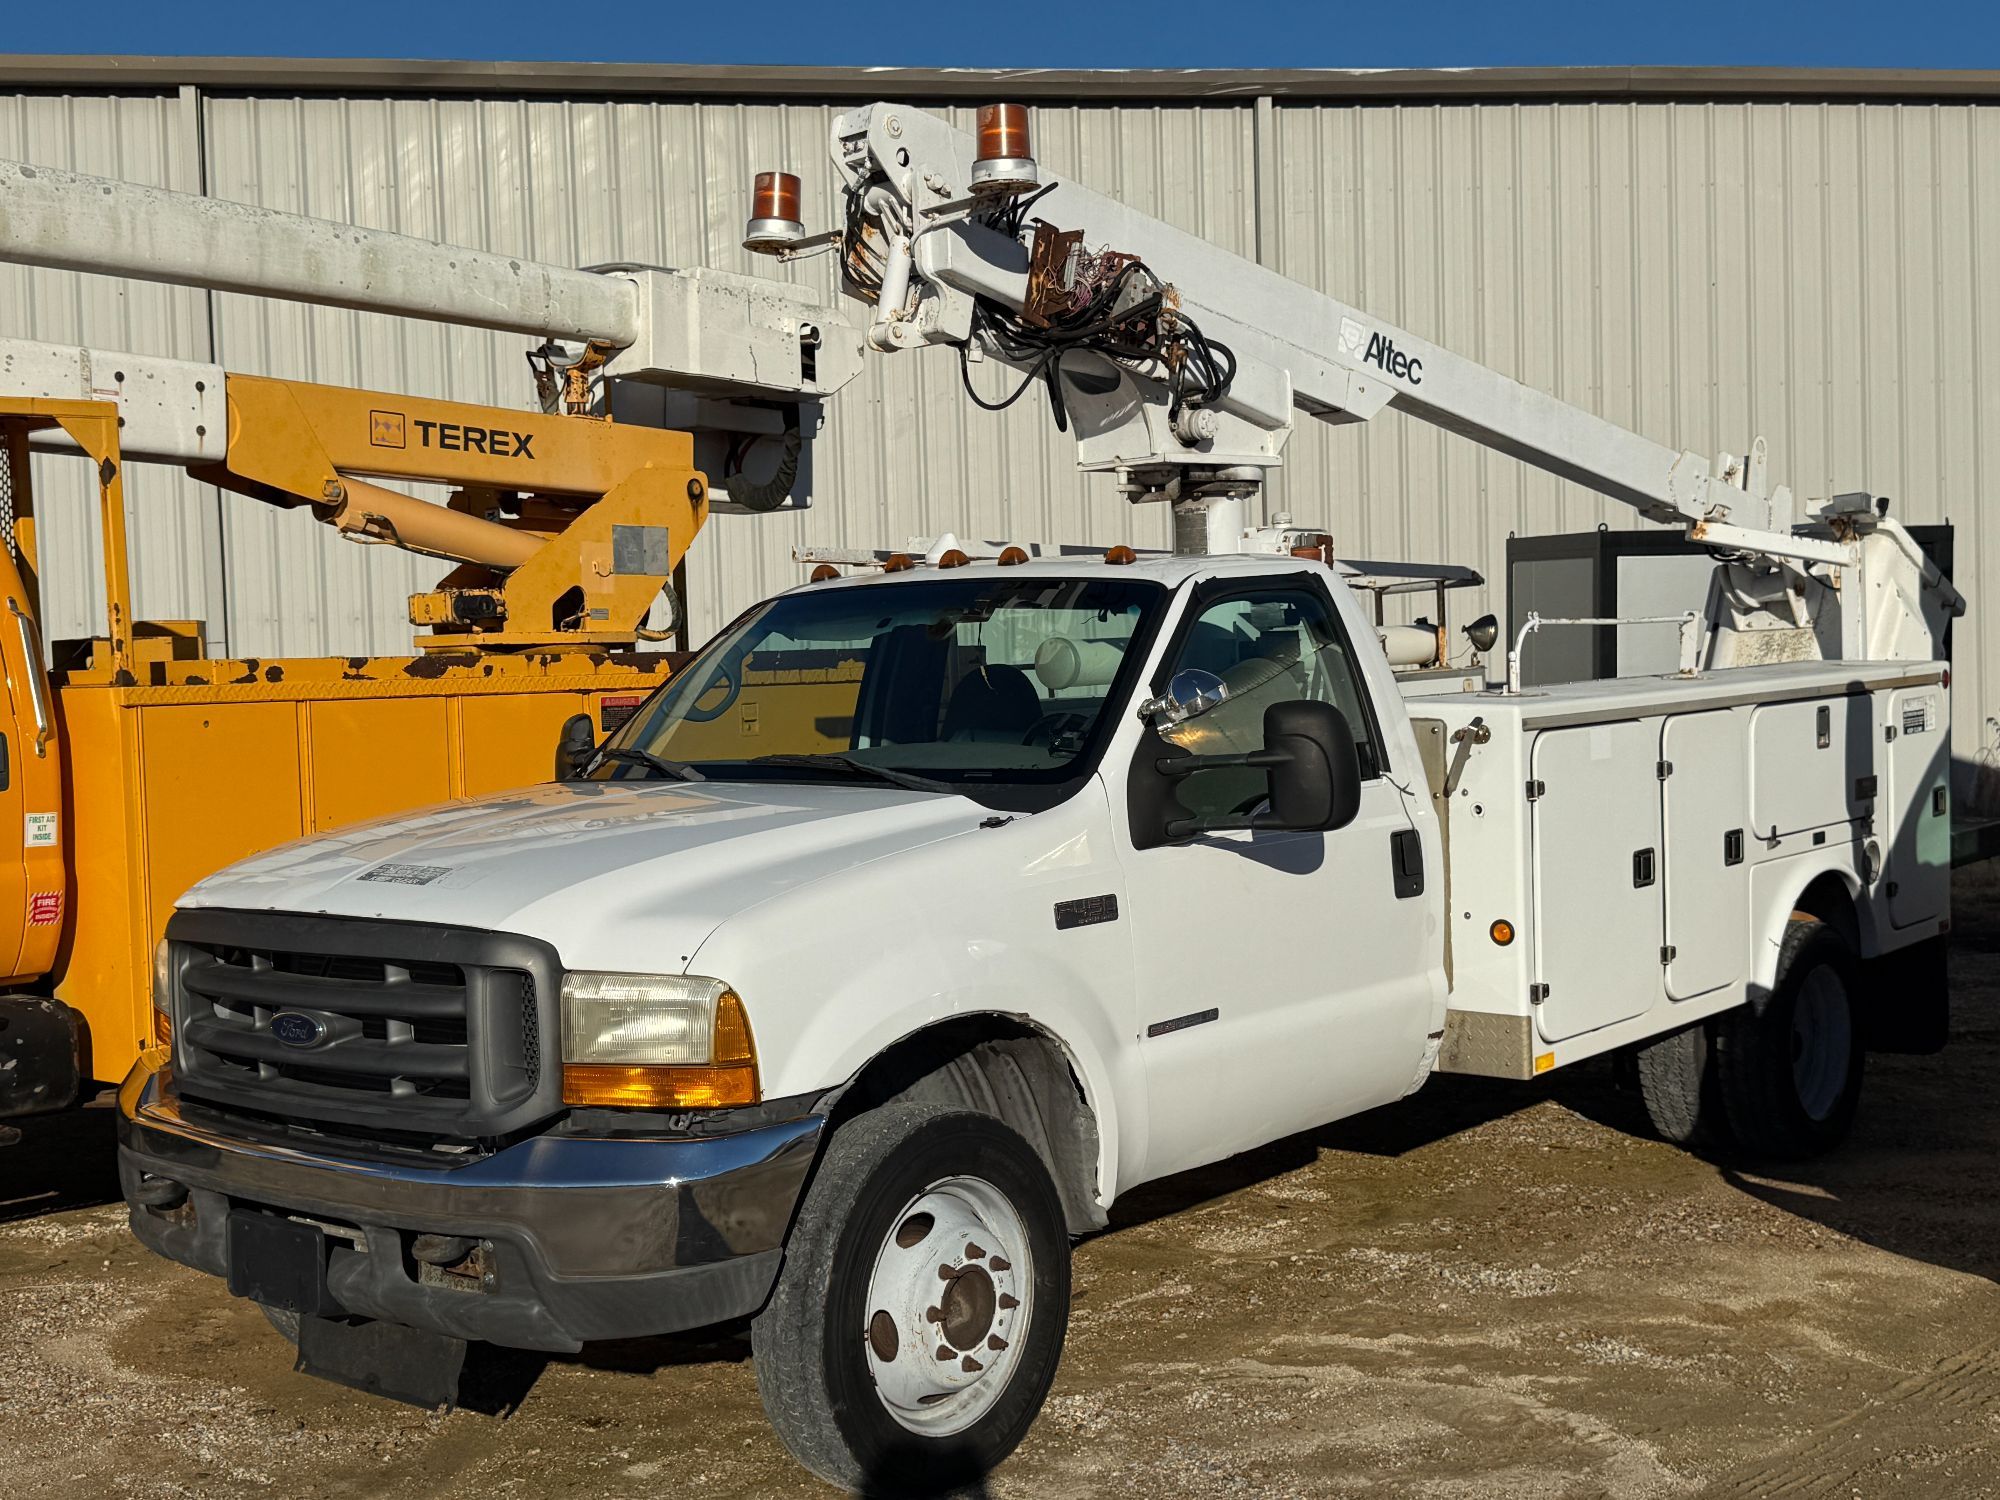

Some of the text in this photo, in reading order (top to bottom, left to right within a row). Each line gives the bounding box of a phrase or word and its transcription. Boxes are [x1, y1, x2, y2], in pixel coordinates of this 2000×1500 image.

[1363, 331, 1422, 385] Altec
[414, 420, 535, 459] TEREX
[32, 833, 52, 841] INSIDE
[37, 898, 57, 907] FIRE
[280, 1017, 311, 1041] Ford
